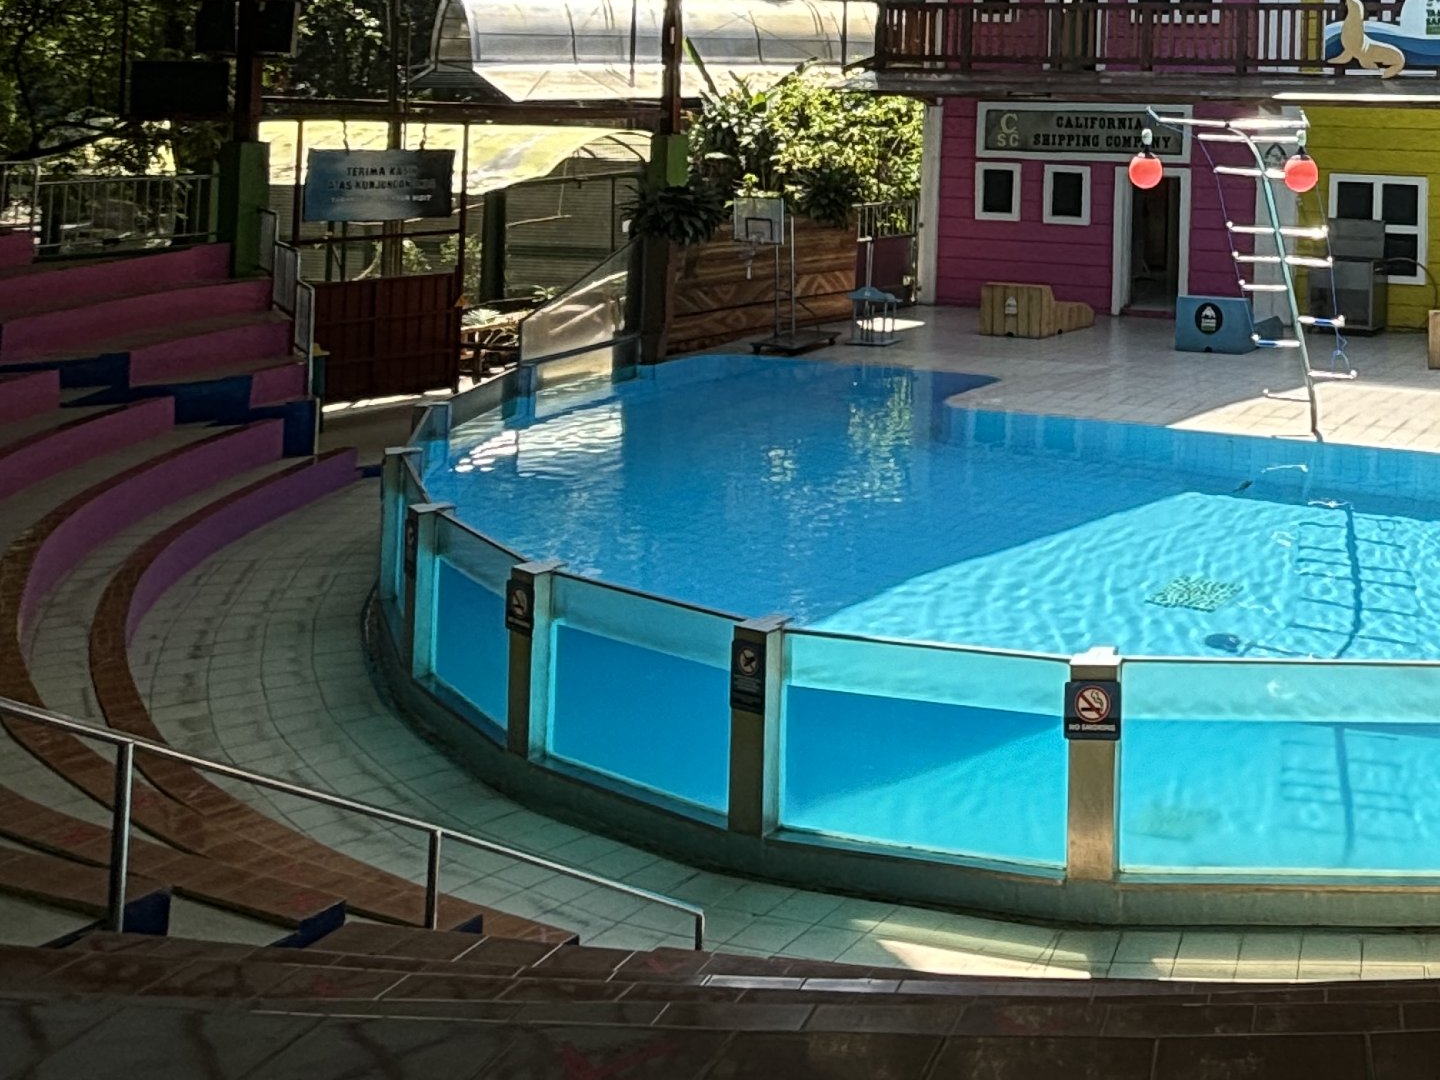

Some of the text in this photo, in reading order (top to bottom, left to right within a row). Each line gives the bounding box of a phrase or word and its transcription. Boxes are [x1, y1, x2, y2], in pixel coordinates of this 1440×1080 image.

[1000, 113, 1019, 134] C
[1056, 116, 1143, 131] CALIFORNIA
[1033, 133, 1172, 149] SHIPPING COMPNY
[346, 166, 386, 177] TERIMA
